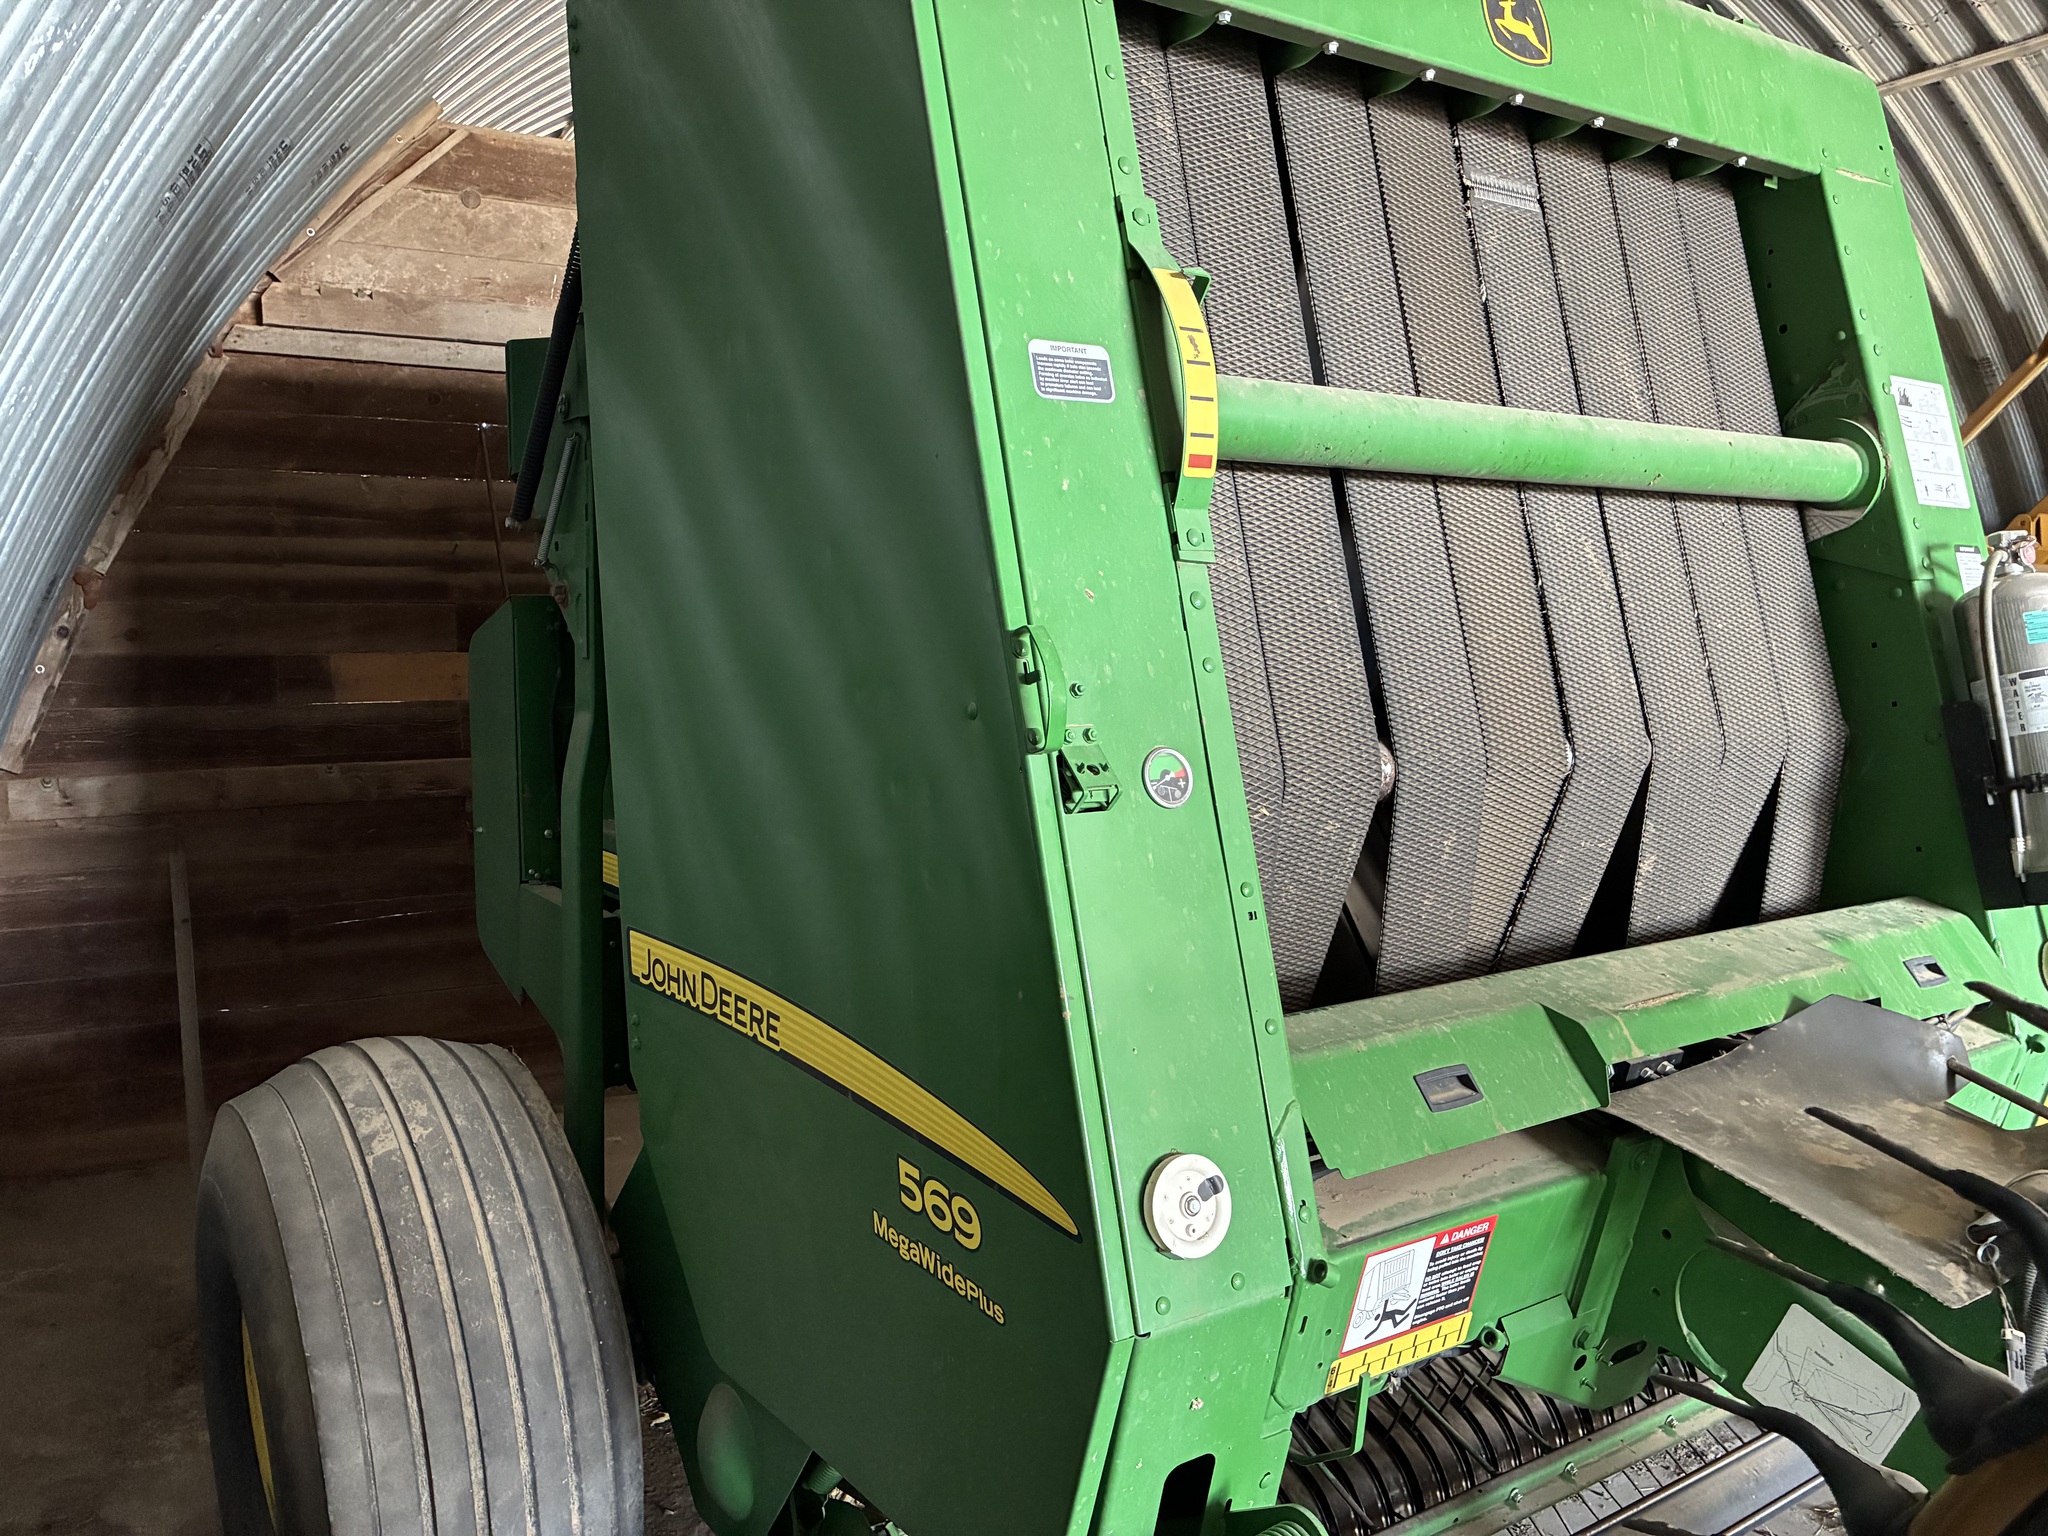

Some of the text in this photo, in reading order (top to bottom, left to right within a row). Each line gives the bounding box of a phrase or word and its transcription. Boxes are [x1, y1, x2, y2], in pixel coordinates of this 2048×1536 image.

[1050, 345, 1087, 354] IMPORTANT
[2008, 677, 2027, 732] WATER
[641, 948, 781, 1048] JOHN DEERE
[898, 1157, 982, 1250] 569
[1450, 1222, 1490, 1242] DANGER
[872, 1210, 1005, 1325] MegaWidePlus
